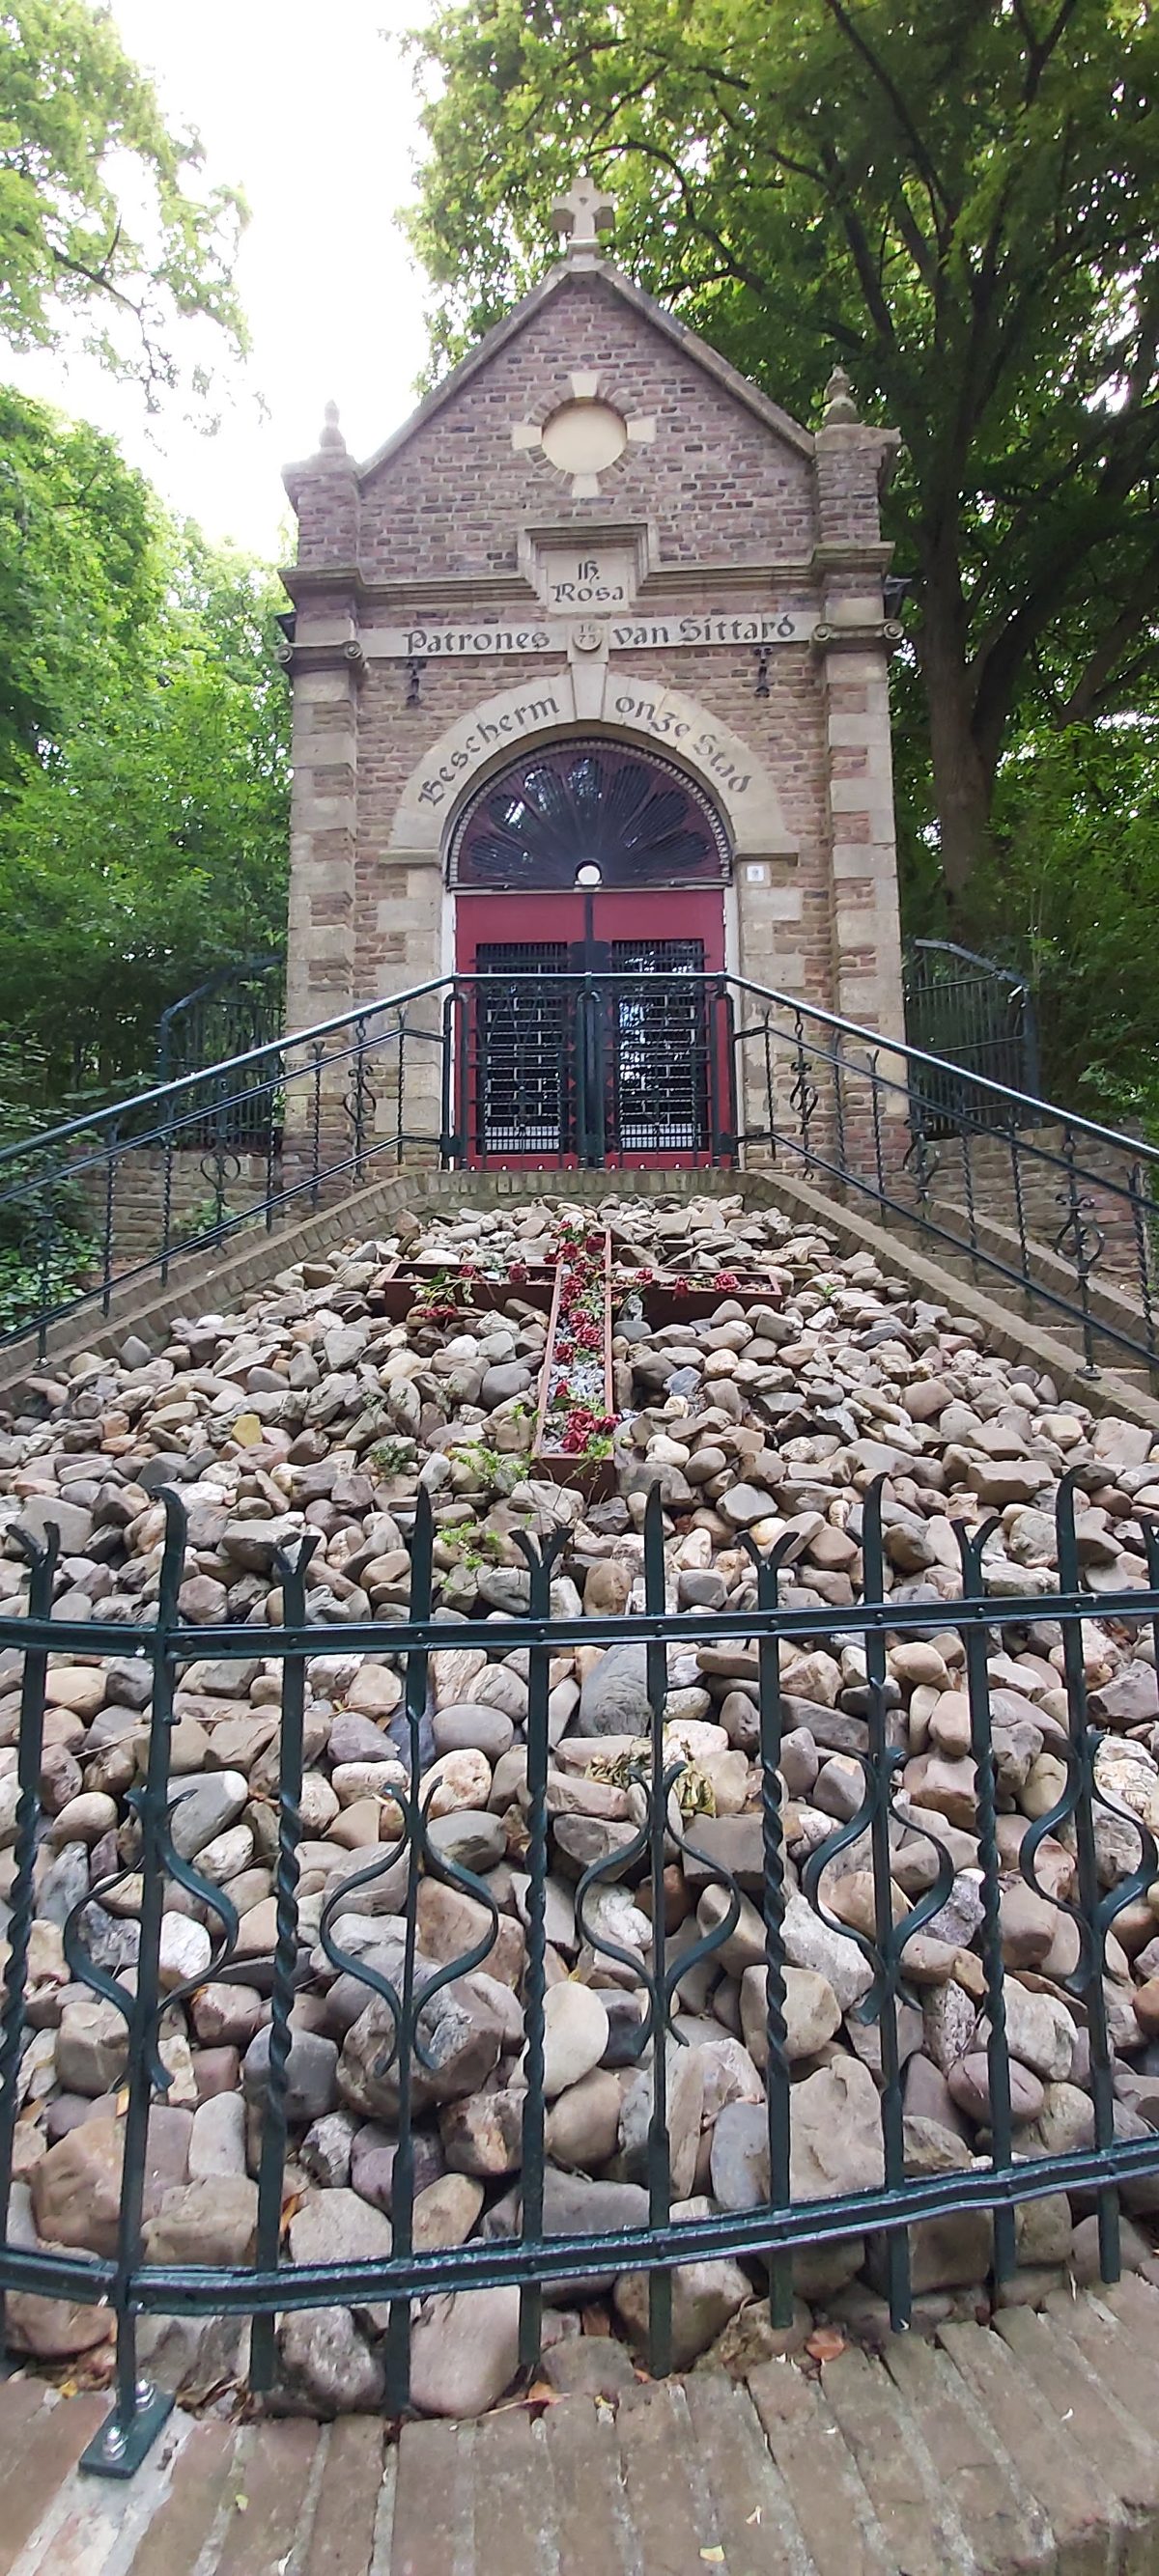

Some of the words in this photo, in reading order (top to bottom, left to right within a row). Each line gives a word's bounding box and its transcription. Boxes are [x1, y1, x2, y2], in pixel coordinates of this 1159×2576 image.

[550, 582, 624, 603] Rosa
[402, 630, 551, 656] Patrones
[612, 626, 669, 646] van
[678, 614, 796, 643] Sittard
[418, 696, 560, 807] Bescherm
[615, 696, 691, 738] onze
[693, 734, 752, 793] Stad
